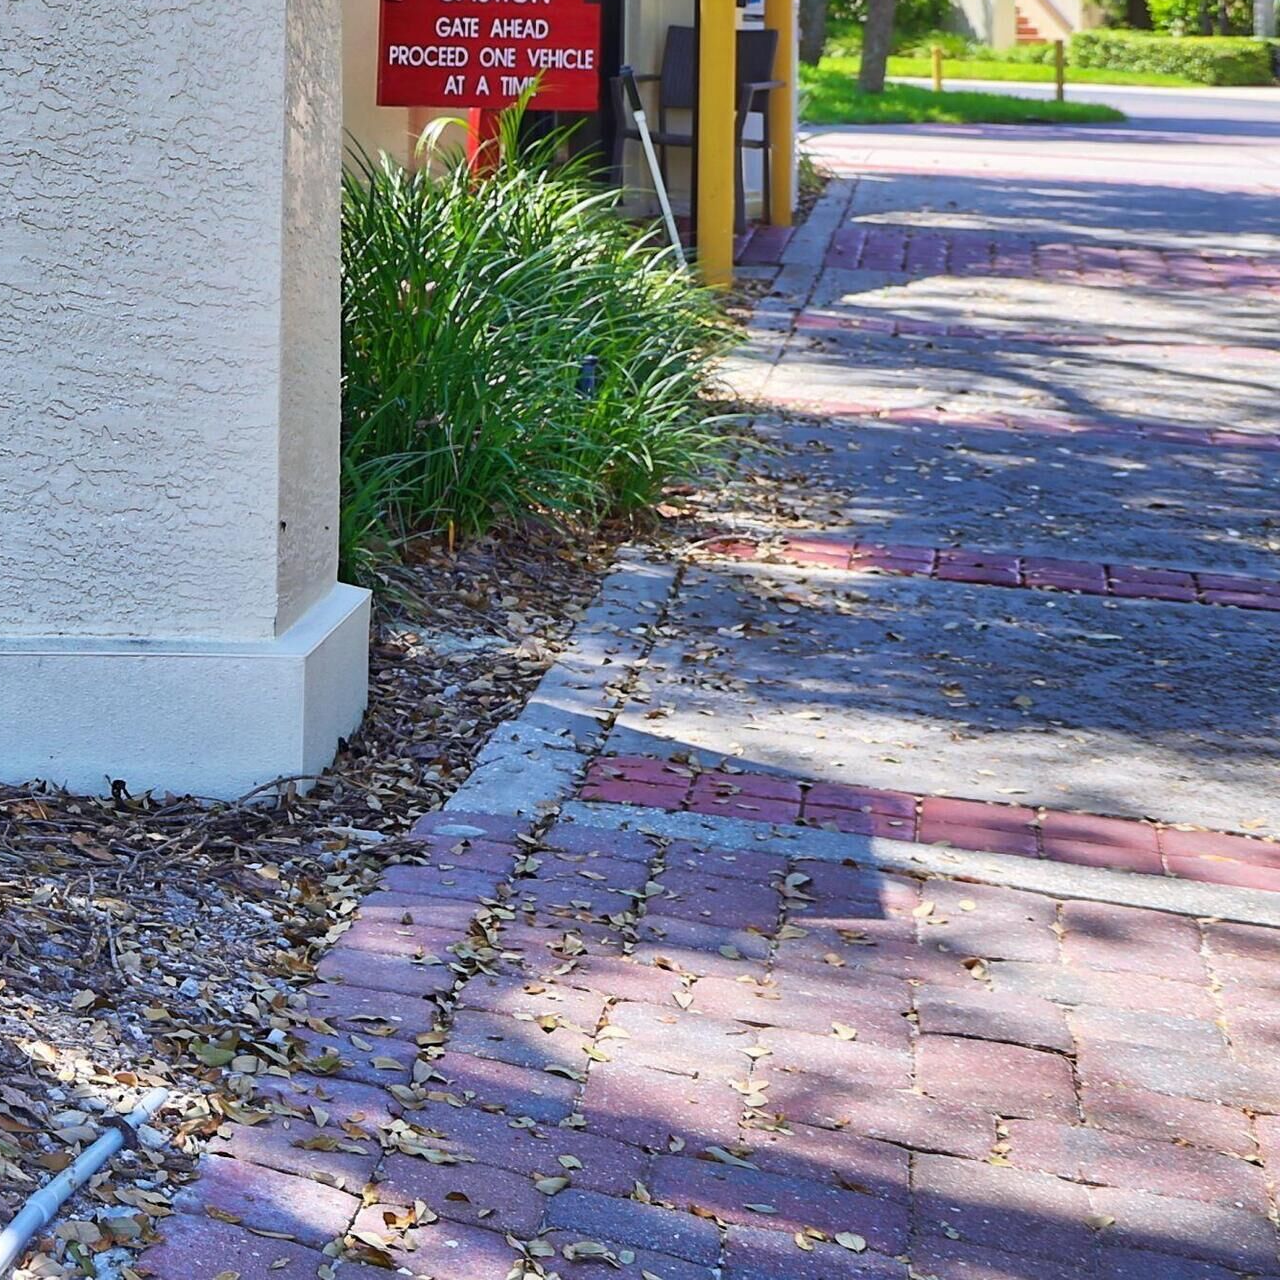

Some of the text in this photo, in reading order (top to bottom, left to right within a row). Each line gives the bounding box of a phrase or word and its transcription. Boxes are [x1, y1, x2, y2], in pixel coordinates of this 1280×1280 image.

[435, 17, 549, 40] GATE AHEAD
[389, 45, 593, 70] PROCEED ONE VEHICLE
[444, 75, 465, 95] AT
[475, 75, 490, 96] A
